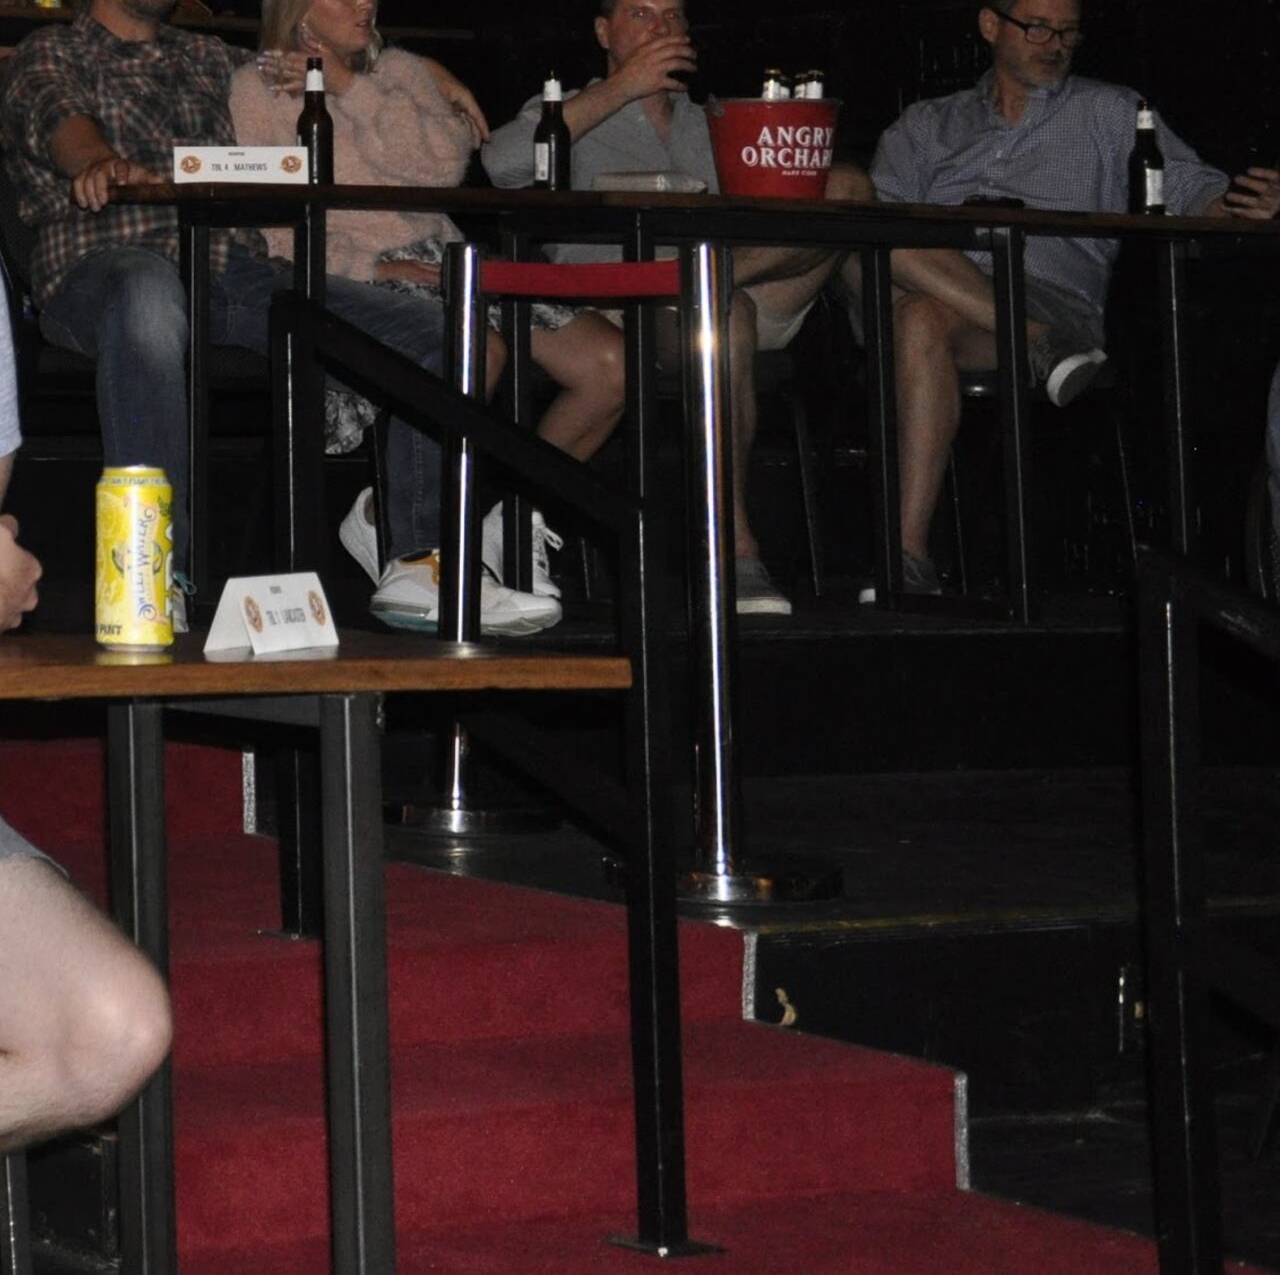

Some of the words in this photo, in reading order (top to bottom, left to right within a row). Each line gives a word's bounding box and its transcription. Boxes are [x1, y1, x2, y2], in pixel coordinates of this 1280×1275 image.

[757, 126, 833, 146] ANGRY
[741, 146, 834, 168] ORCHAR
[234, 163, 268, 172] MATHEWS
